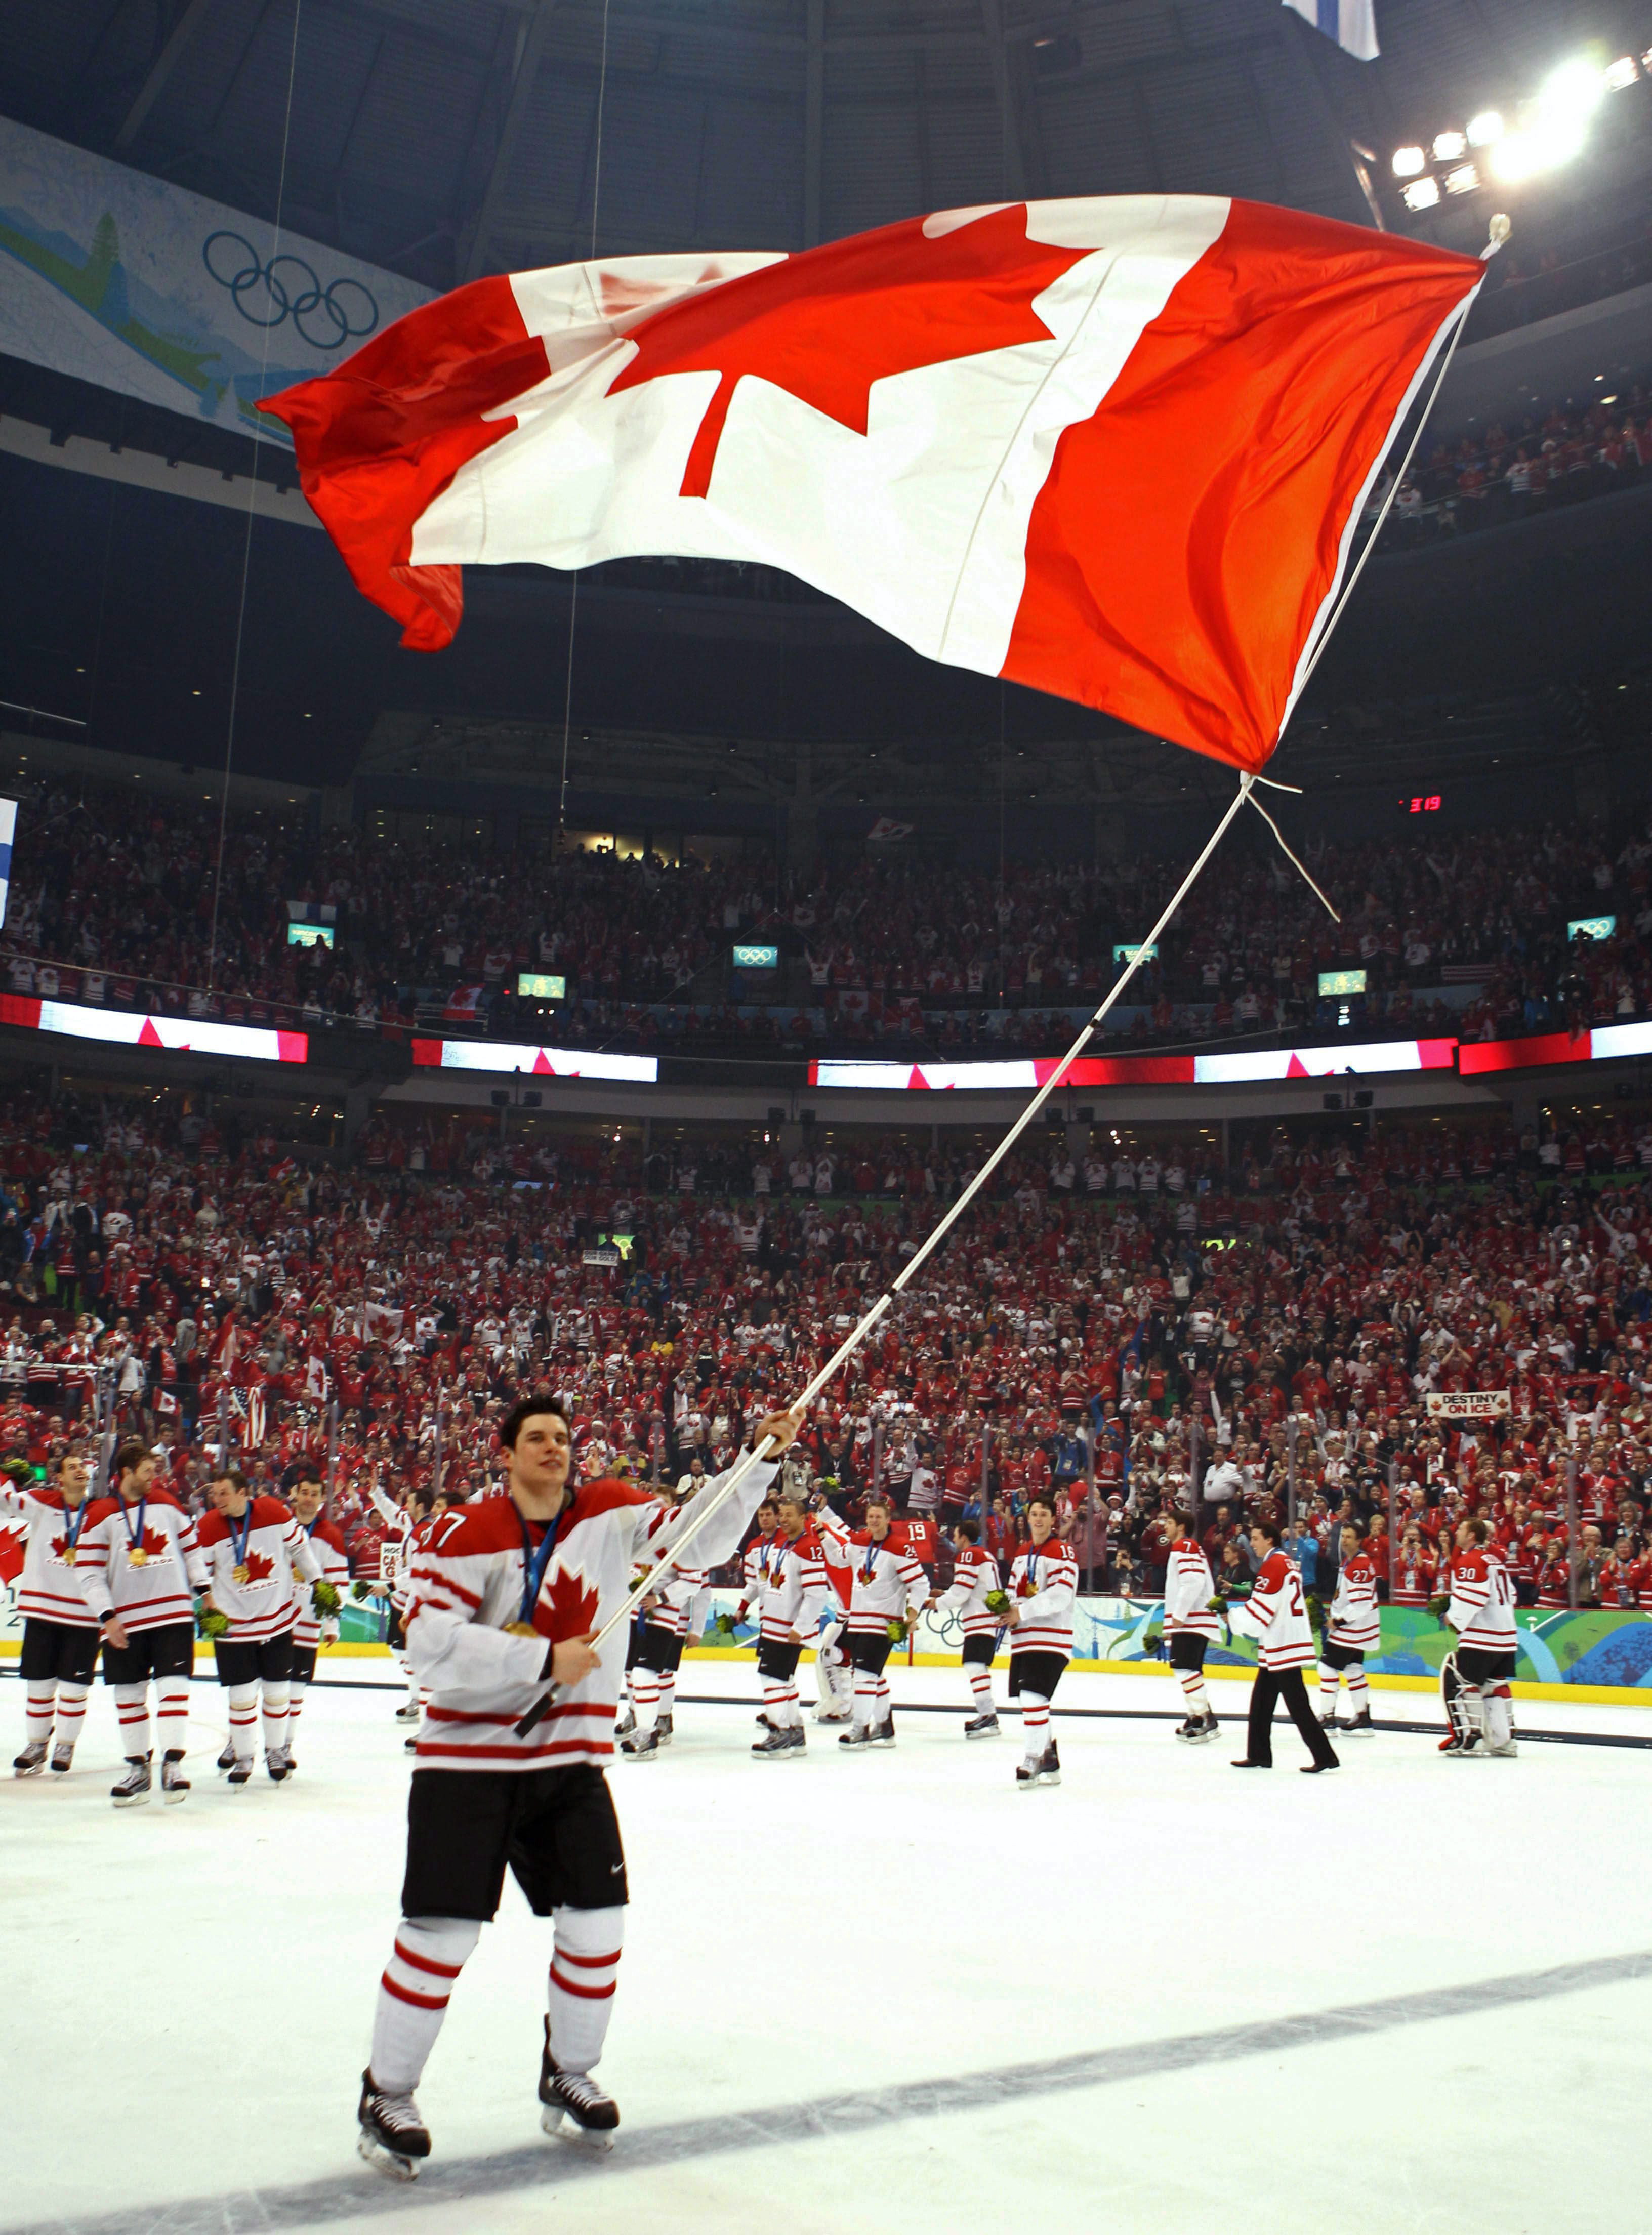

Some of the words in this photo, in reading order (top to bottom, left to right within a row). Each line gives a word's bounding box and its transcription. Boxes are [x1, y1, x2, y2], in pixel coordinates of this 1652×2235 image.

[1442, 1394, 1498, 1404] DESTINY
[1448, 1404, 1467, 1414] ON
[1471, 1404, 1492, 1413] ICE
[907, 1524, 926, 1541] 19
[1183, 1541, 1191, 1552] 7
[810, 1546, 823, 1560] 12
[960, 1551, 973, 1563] 10
[1352, 1570, 1369, 1582] 27
[1458, 1567, 1476, 1580] 30
